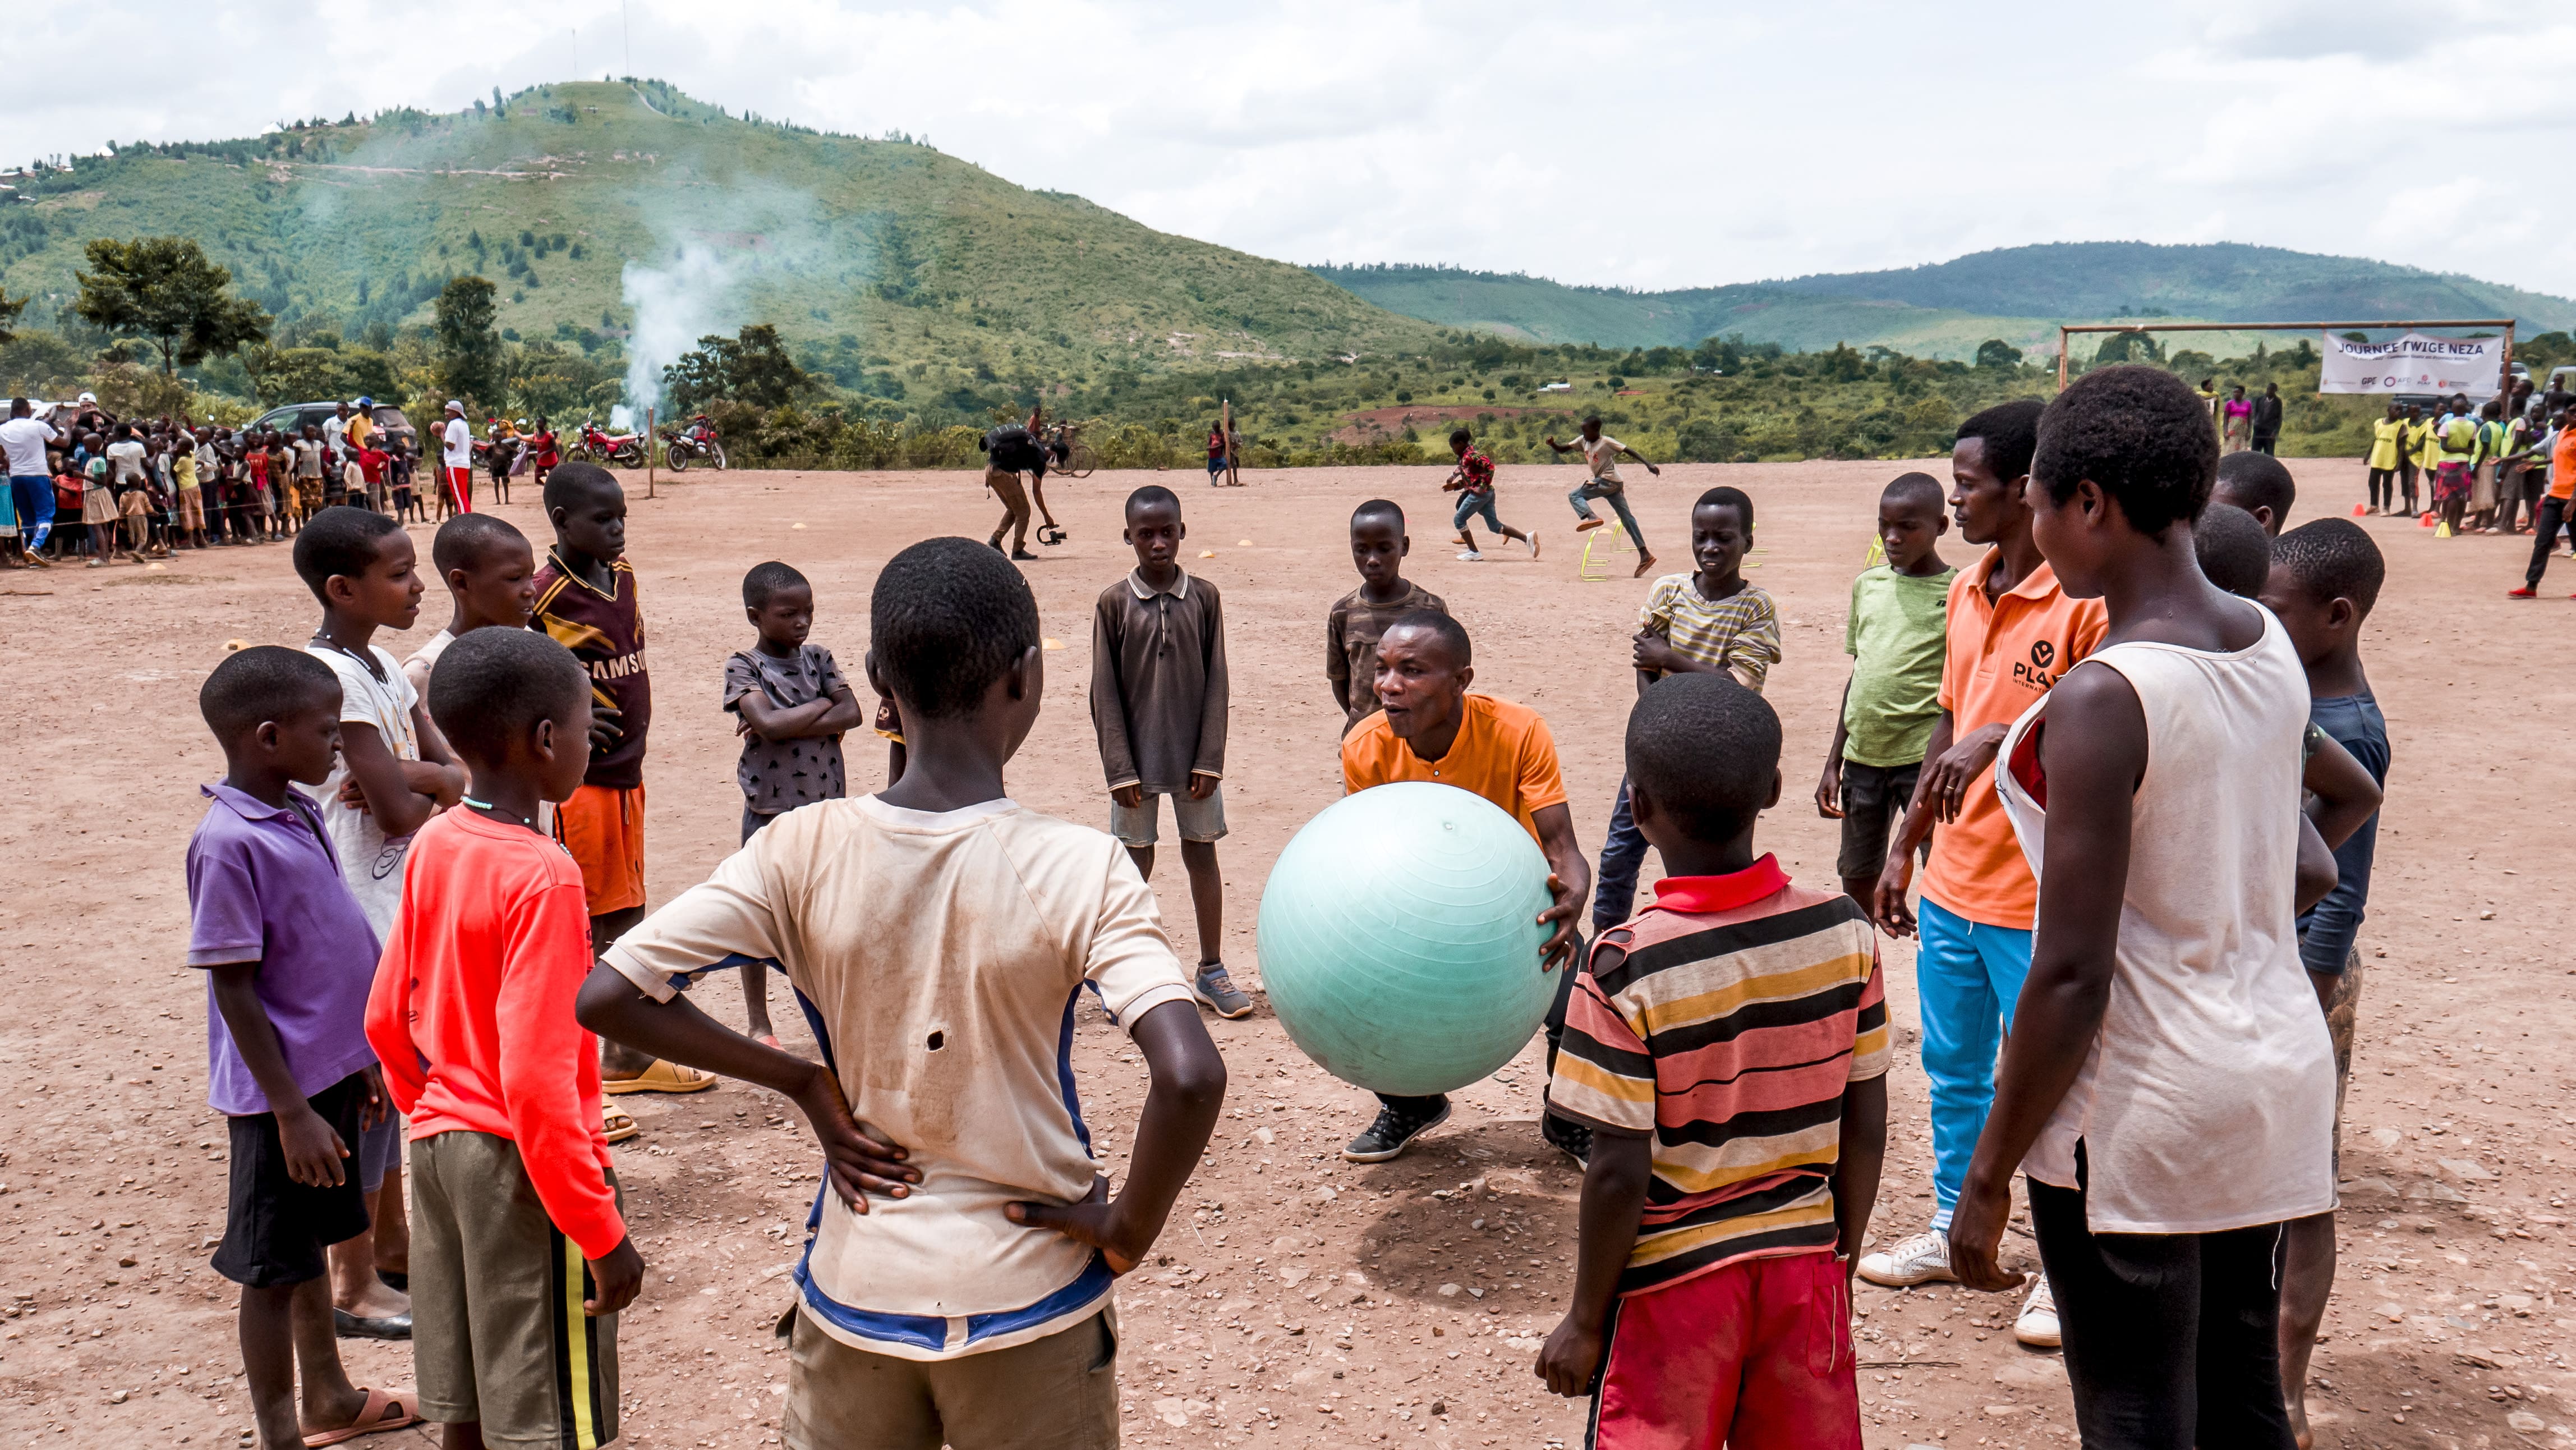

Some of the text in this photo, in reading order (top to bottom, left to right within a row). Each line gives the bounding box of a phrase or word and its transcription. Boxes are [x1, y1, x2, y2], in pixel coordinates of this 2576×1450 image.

[2339, 341, 2484, 355] JOURNEE TWIGE NEZA
[580, 648, 646, 680] AMSU
[2012, 677, 2048, 694] INTERNATI
